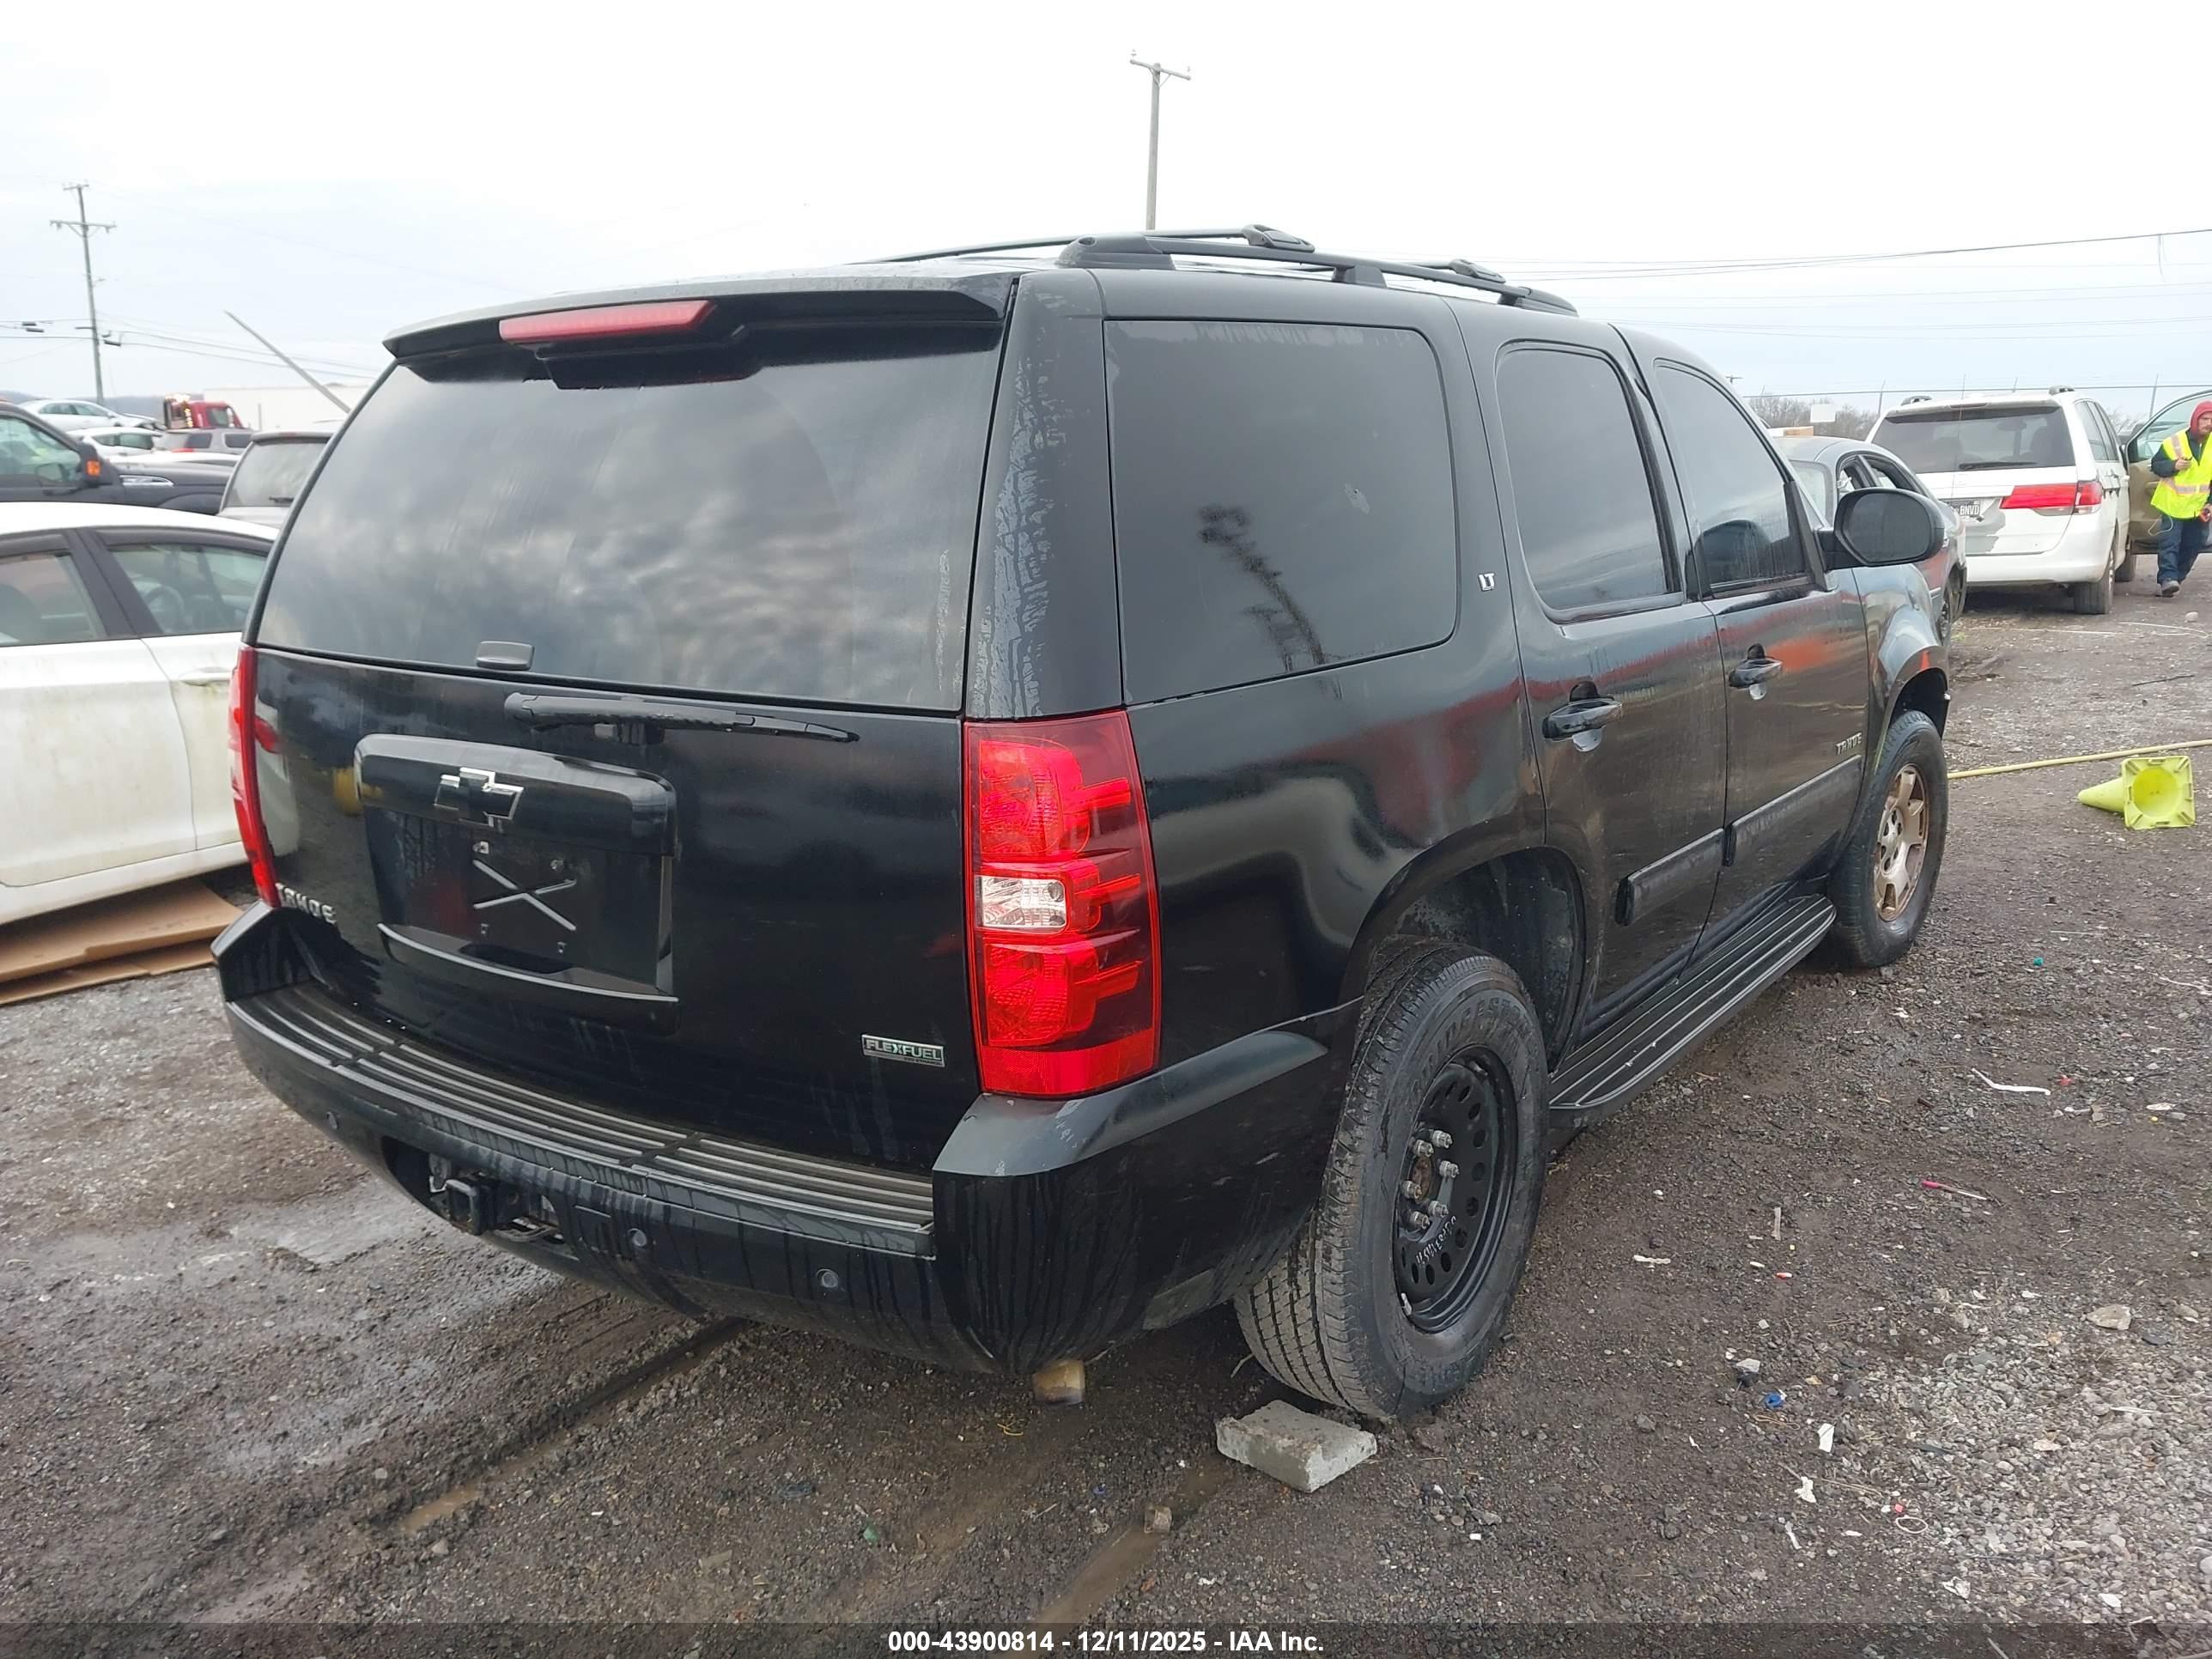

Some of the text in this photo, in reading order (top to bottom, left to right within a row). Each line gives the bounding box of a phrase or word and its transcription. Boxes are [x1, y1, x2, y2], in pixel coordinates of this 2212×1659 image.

[1478, 573, 1495, 592] LT
[1835, 732, 1863, 756] TAHOE
[865, 1038, 942, 1060] FLEXFUEL
